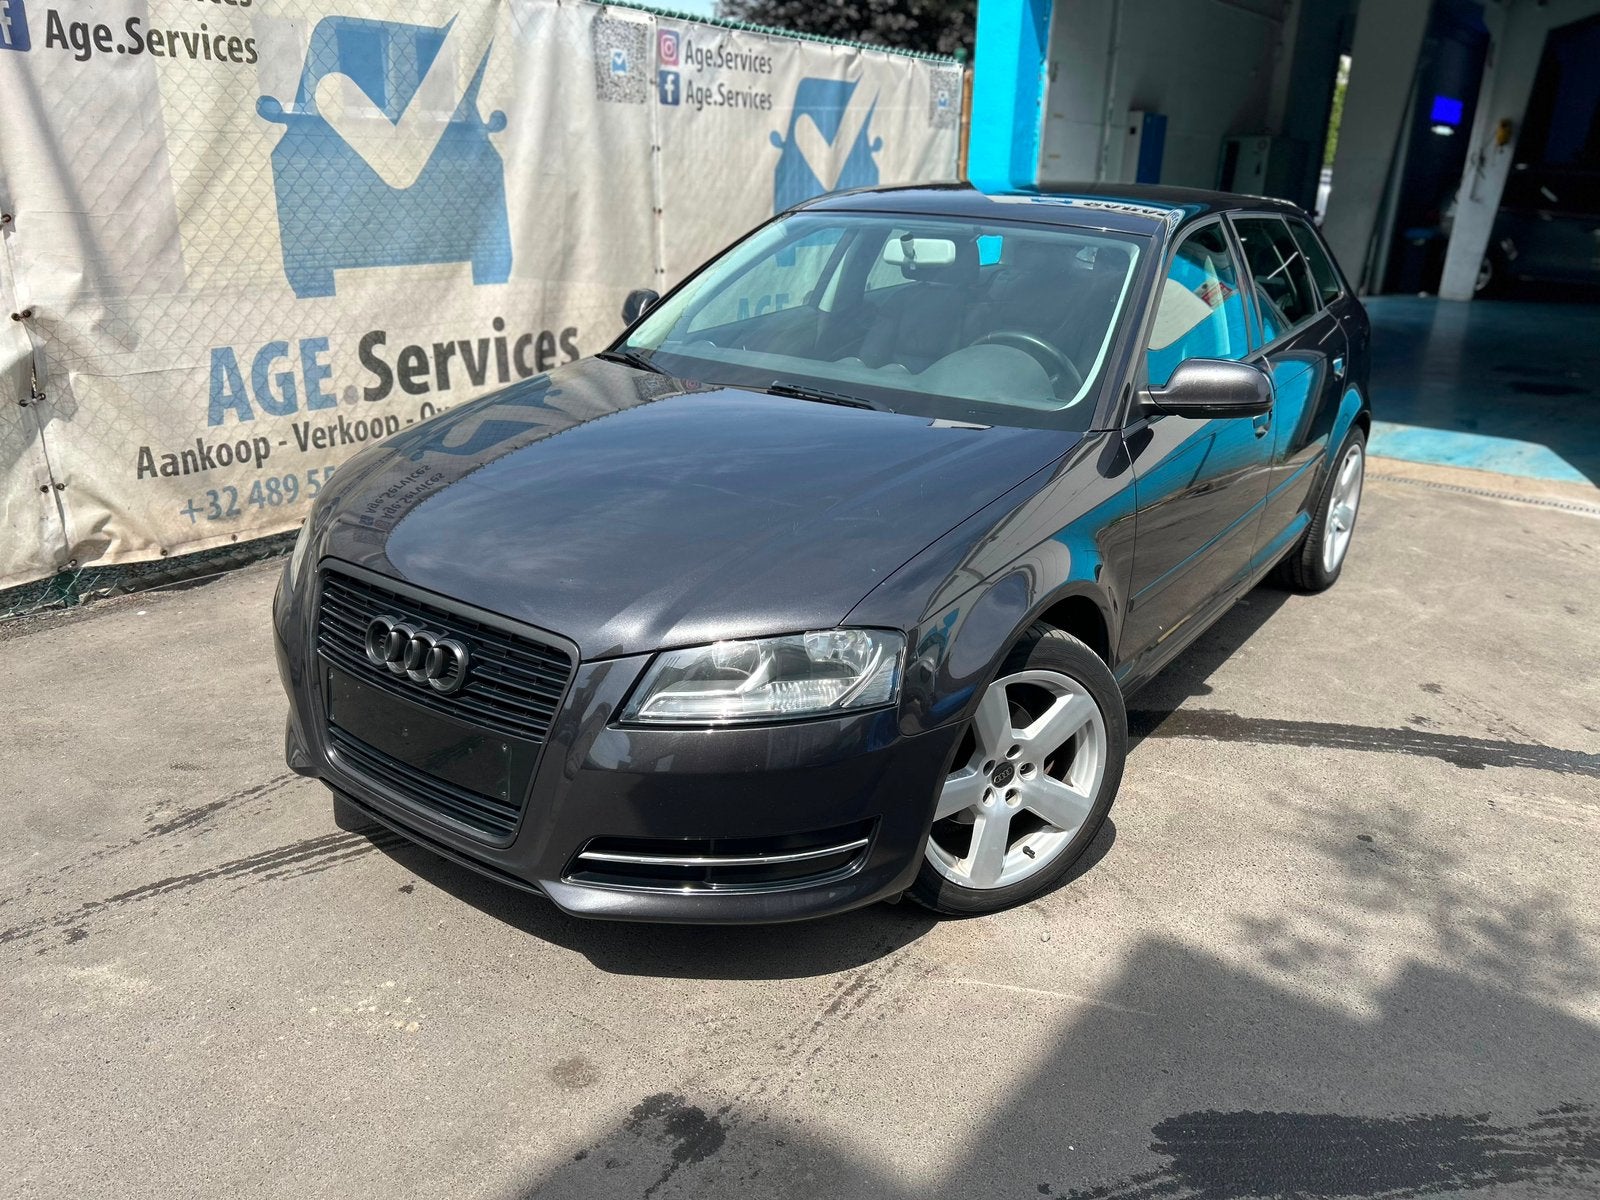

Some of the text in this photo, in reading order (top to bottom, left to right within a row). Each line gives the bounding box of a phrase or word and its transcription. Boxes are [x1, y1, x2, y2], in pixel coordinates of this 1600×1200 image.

[46, 9, 257, 64] Age.Services
[685, 40, 772, 74] Age.Services
[686, 80, 772, 111] Age.Services
[207, 316, 580, 427] AGE.Services
[137, 435, 270, 479] Aankoop
[292, 415, 400, 452] Verkoop
[180, 485, 242, 523] +32
[248, 473, 300, 509] 489
